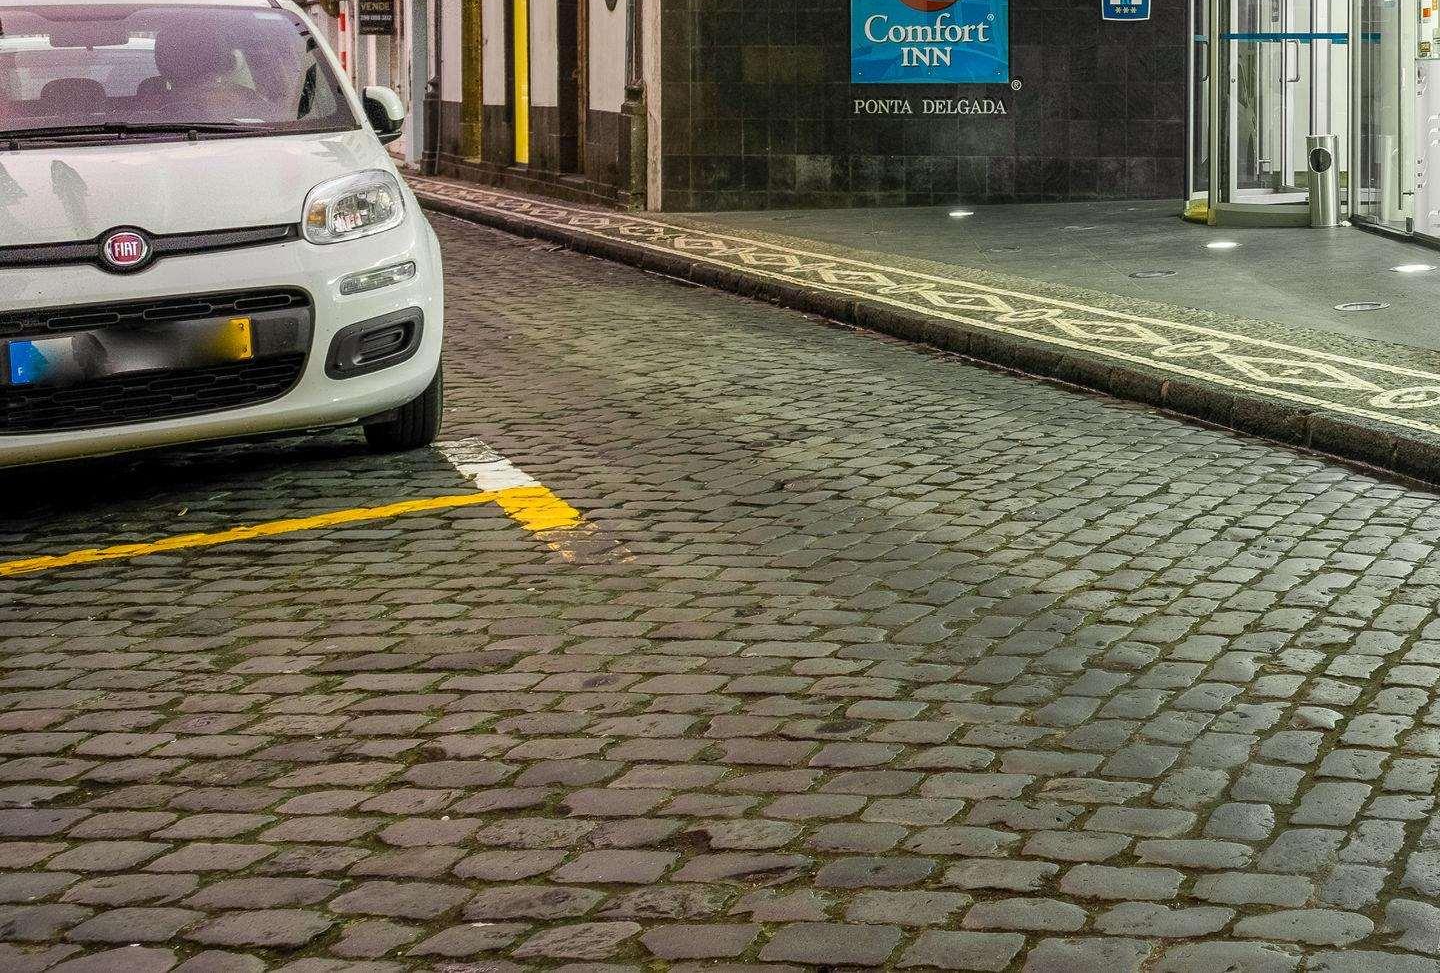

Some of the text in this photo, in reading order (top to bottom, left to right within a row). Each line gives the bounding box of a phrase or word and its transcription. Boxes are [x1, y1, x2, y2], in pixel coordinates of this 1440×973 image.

[864, 12, 990, 43] Comfort
[900, 46, 953, 67] INN
[853, 99, 1007, 115] PONTA DELGADA
[114, 241, 138, 257] FIAT
